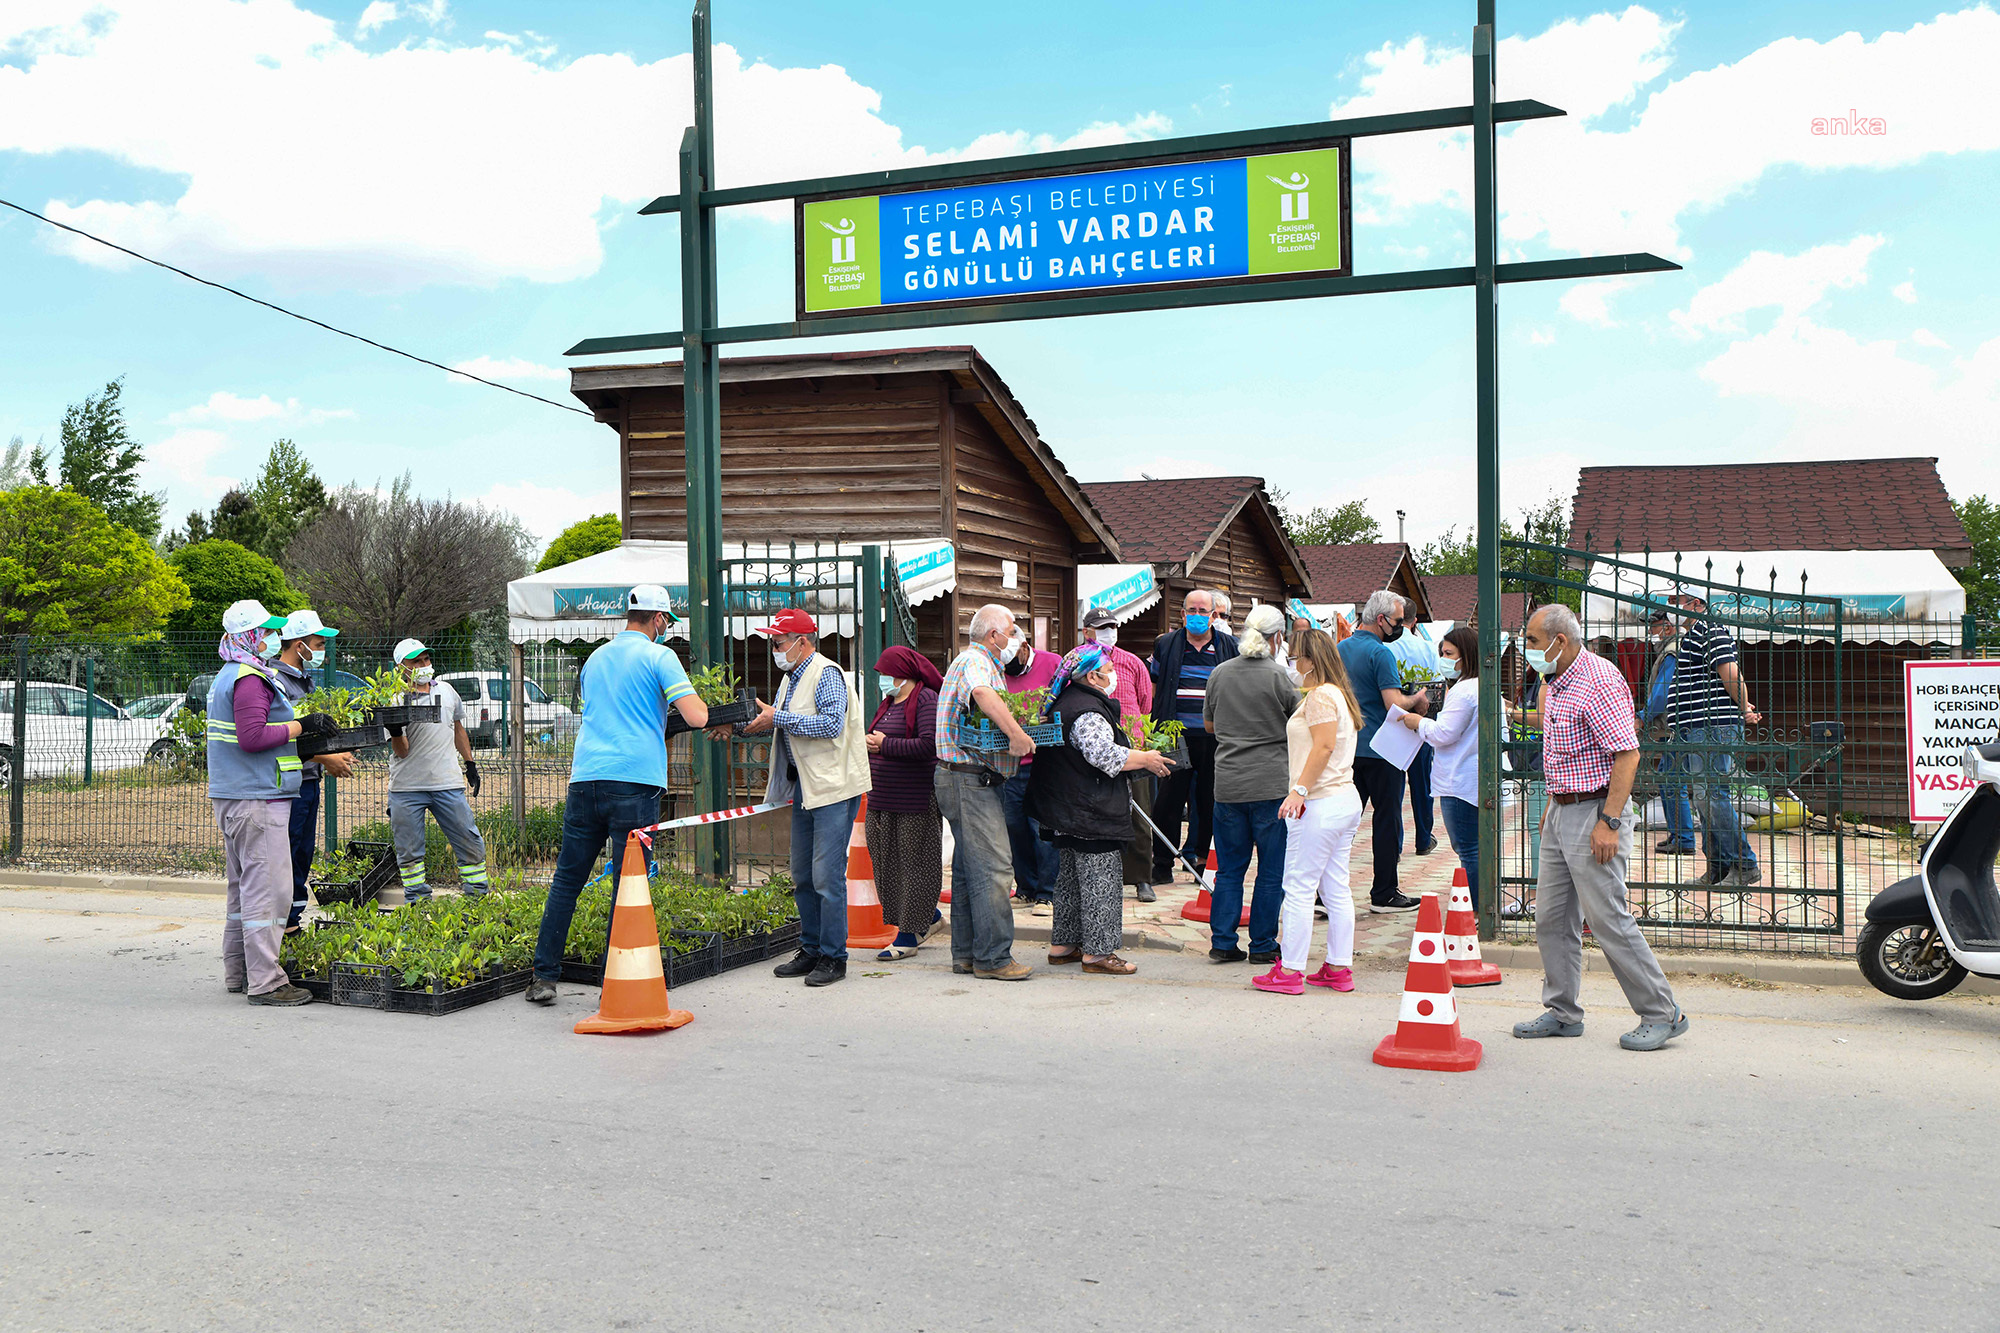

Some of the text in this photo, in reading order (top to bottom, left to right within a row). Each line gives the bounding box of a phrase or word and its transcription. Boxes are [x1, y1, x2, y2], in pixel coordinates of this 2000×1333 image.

[902, 194, 1031, 219] TEPEBAŞI
[1057, 206, 1215, 245] VARDAR
[1268, 231, 1321, 244] TEPEBAŞI
[821, 272, 865, 285] TEPEBAŞI
[904, 256, 1032, 291] GÖNÜLLÜ
[576, 593, 624, 615] Hayat
[1915, 774, 1987, 791] YASA
